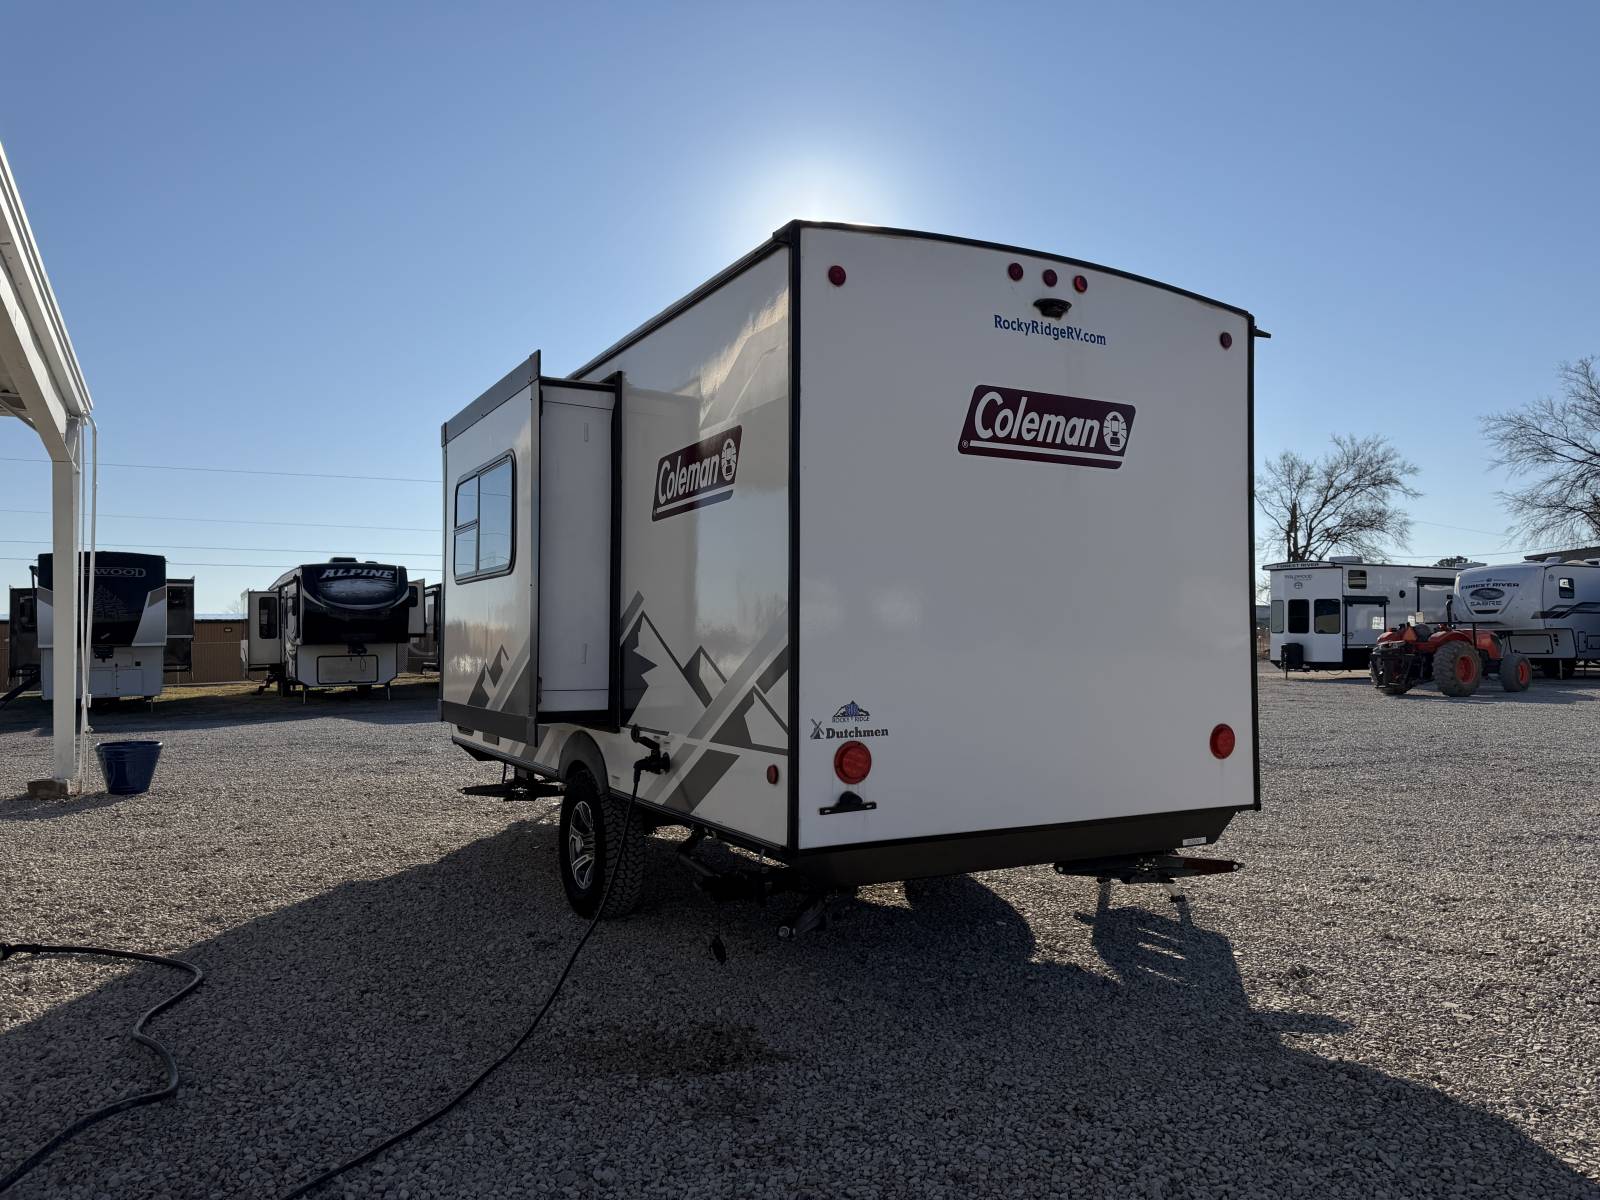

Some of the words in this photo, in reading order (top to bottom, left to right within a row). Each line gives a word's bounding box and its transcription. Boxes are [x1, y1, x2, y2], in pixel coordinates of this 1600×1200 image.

[994, 315, 1107, 346] RockyRidgeRV.com
[974, 391, 1101, 448] Coleman
[658, 455, 720, 504] Coleman
[320, 568, 395, 579] ALPINE
[826, 726, 889, 739] Dutchmen
